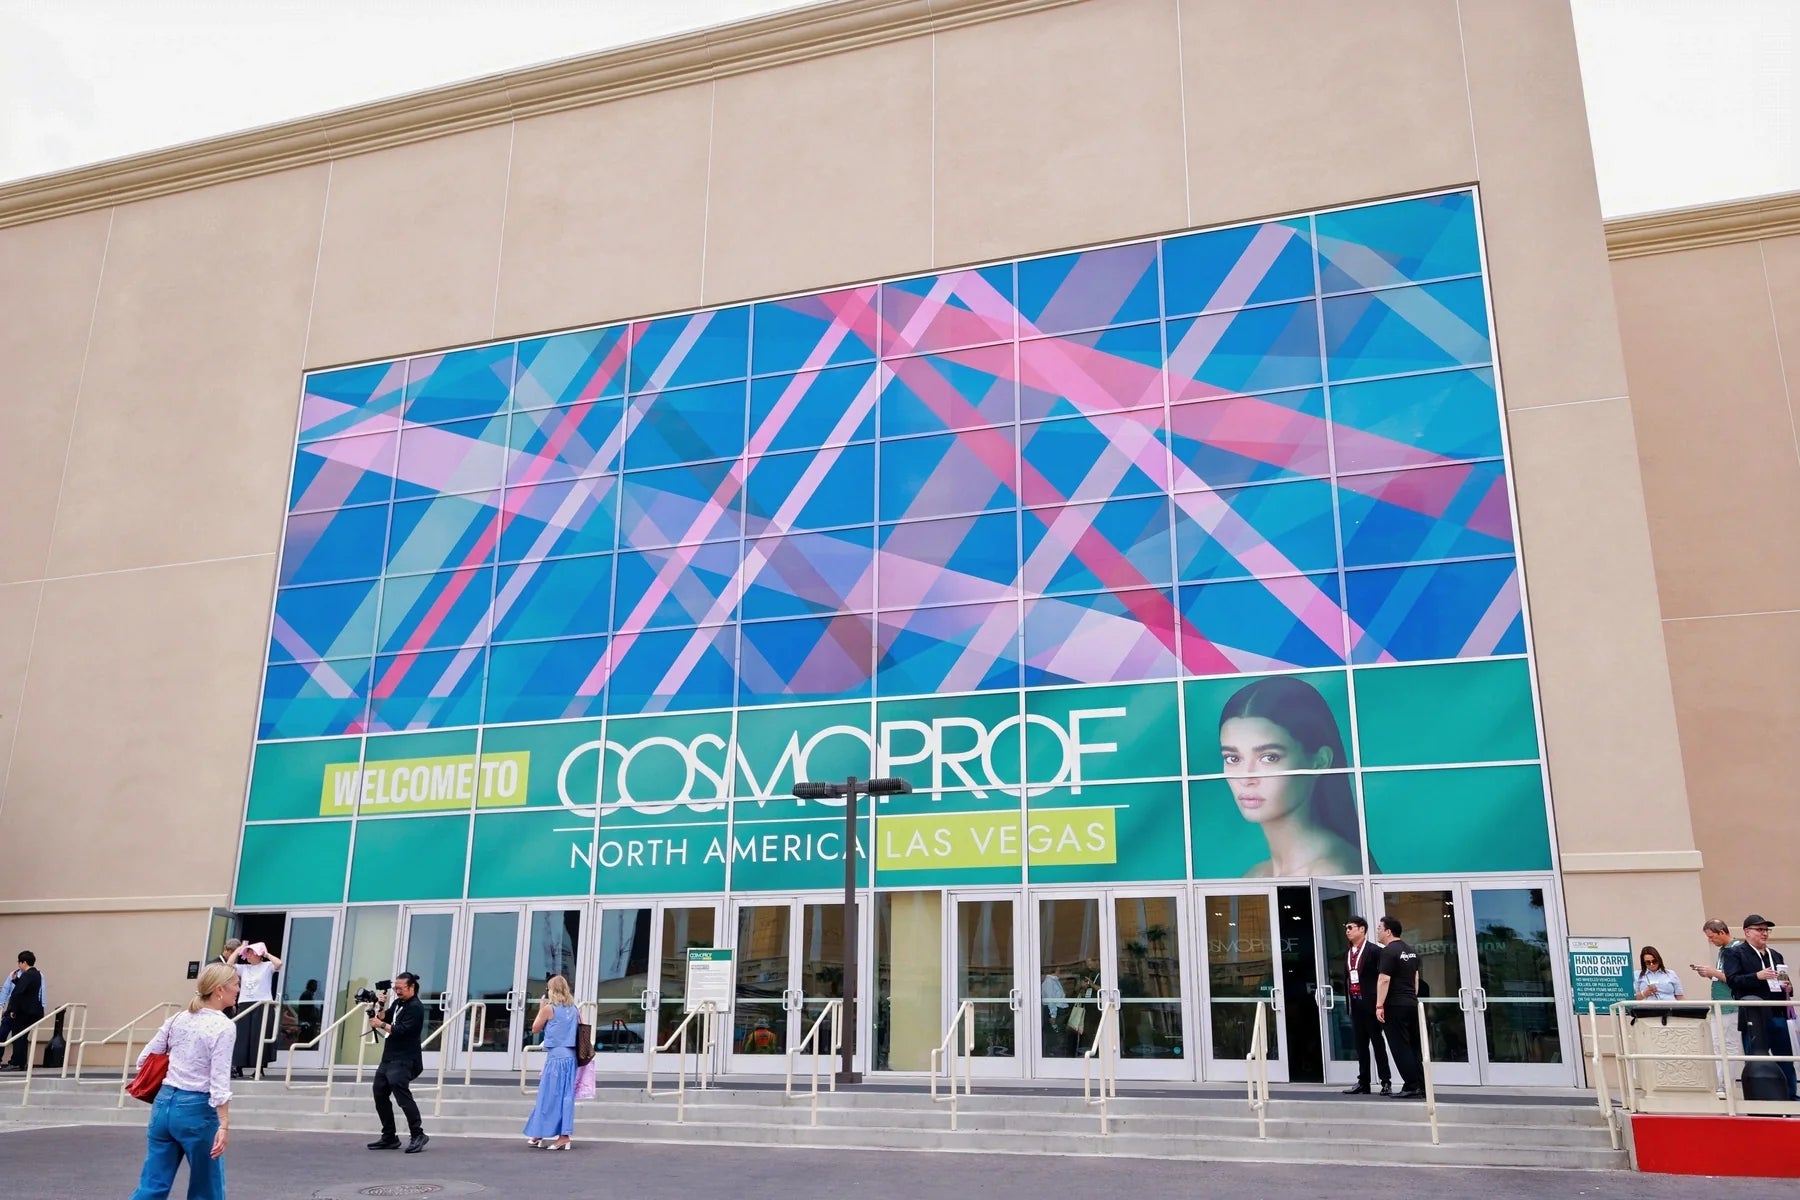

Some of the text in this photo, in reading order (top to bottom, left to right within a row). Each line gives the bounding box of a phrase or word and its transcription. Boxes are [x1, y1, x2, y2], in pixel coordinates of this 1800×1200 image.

[334, 760, 519, 806] WELCOME TO
[557, 707, 1127, 818] COSMOPROF
[570, 822, 1106, 869] NORTH AMERICA LAS VEGAS
[1575, 955, 1627, 965] HAND CARRY
[1576, 965, 1621, 975] DOOR ONLY
